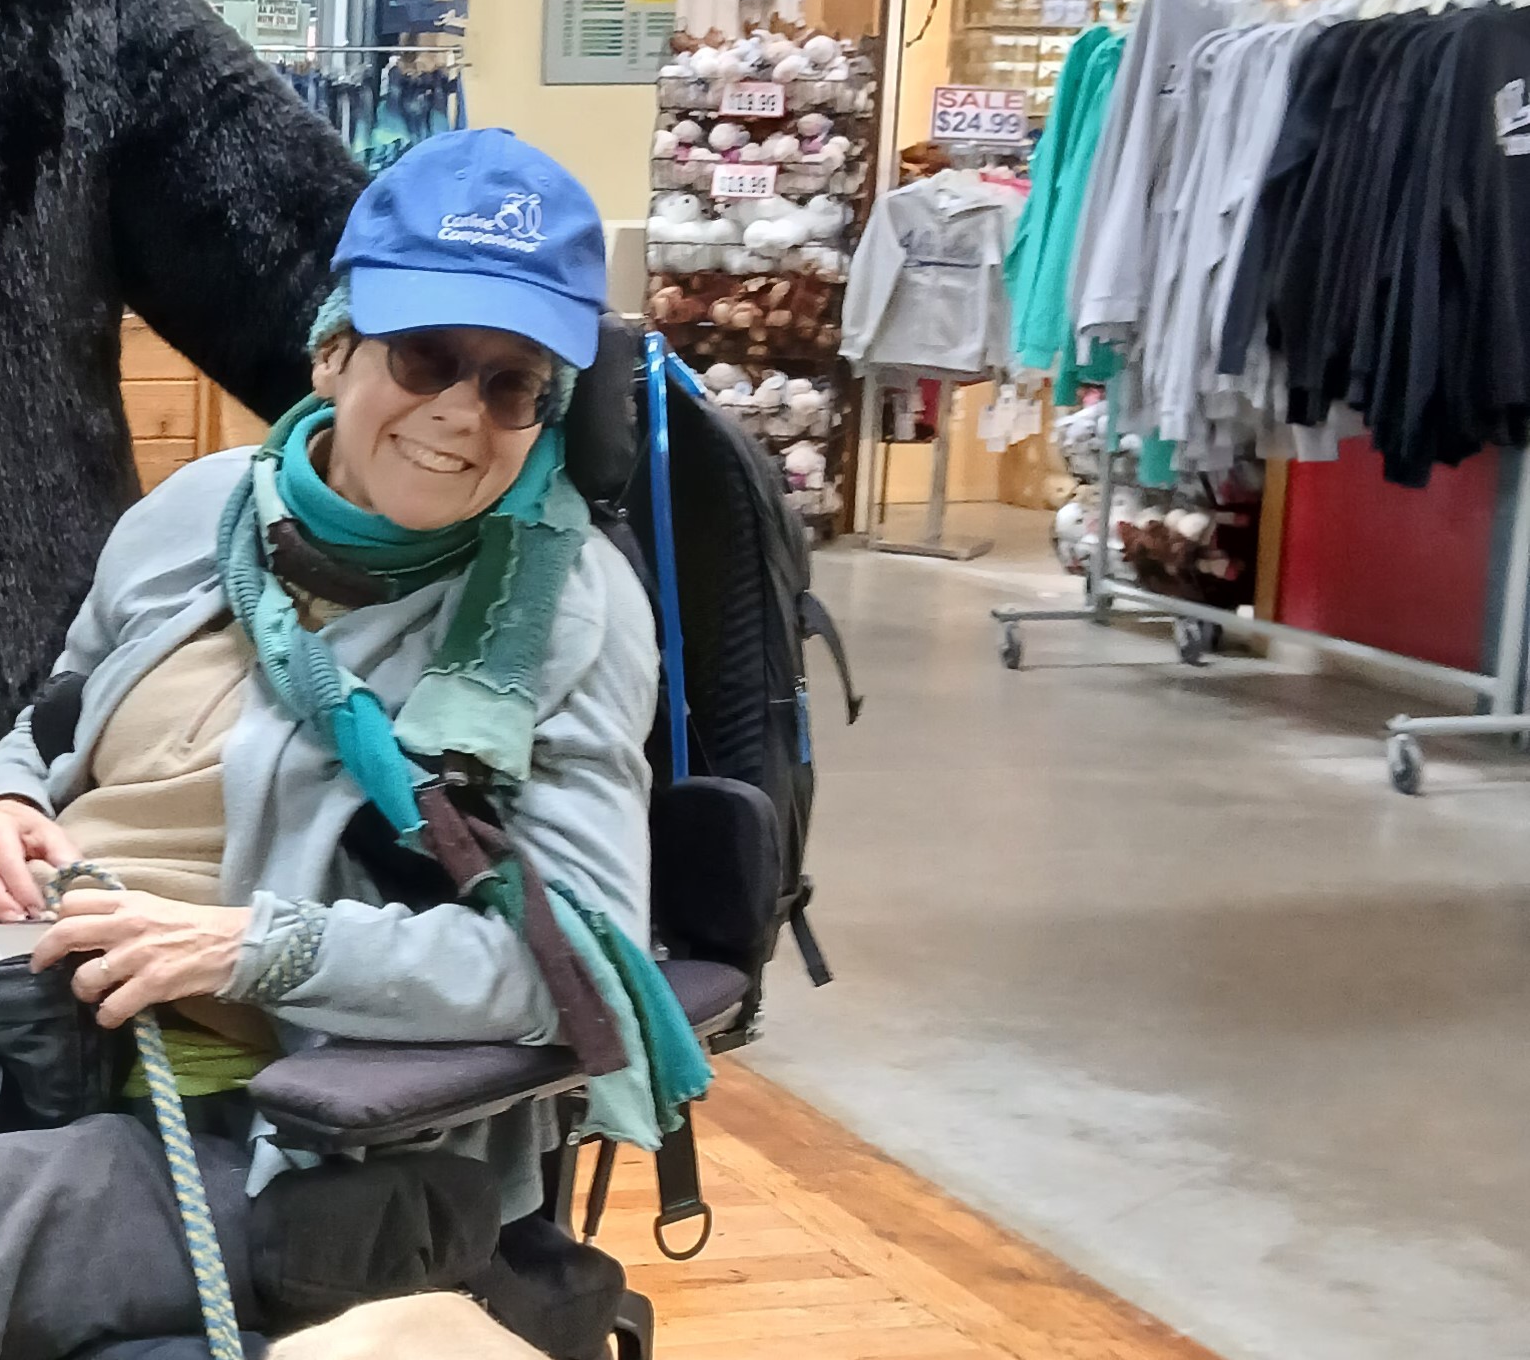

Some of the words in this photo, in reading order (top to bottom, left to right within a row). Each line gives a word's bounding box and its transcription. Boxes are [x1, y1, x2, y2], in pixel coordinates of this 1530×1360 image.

[938, 90, 1024, 110] SALE
[936, 109, 1021, 134] $24.99
[437, 227, 541, 253] Companions
